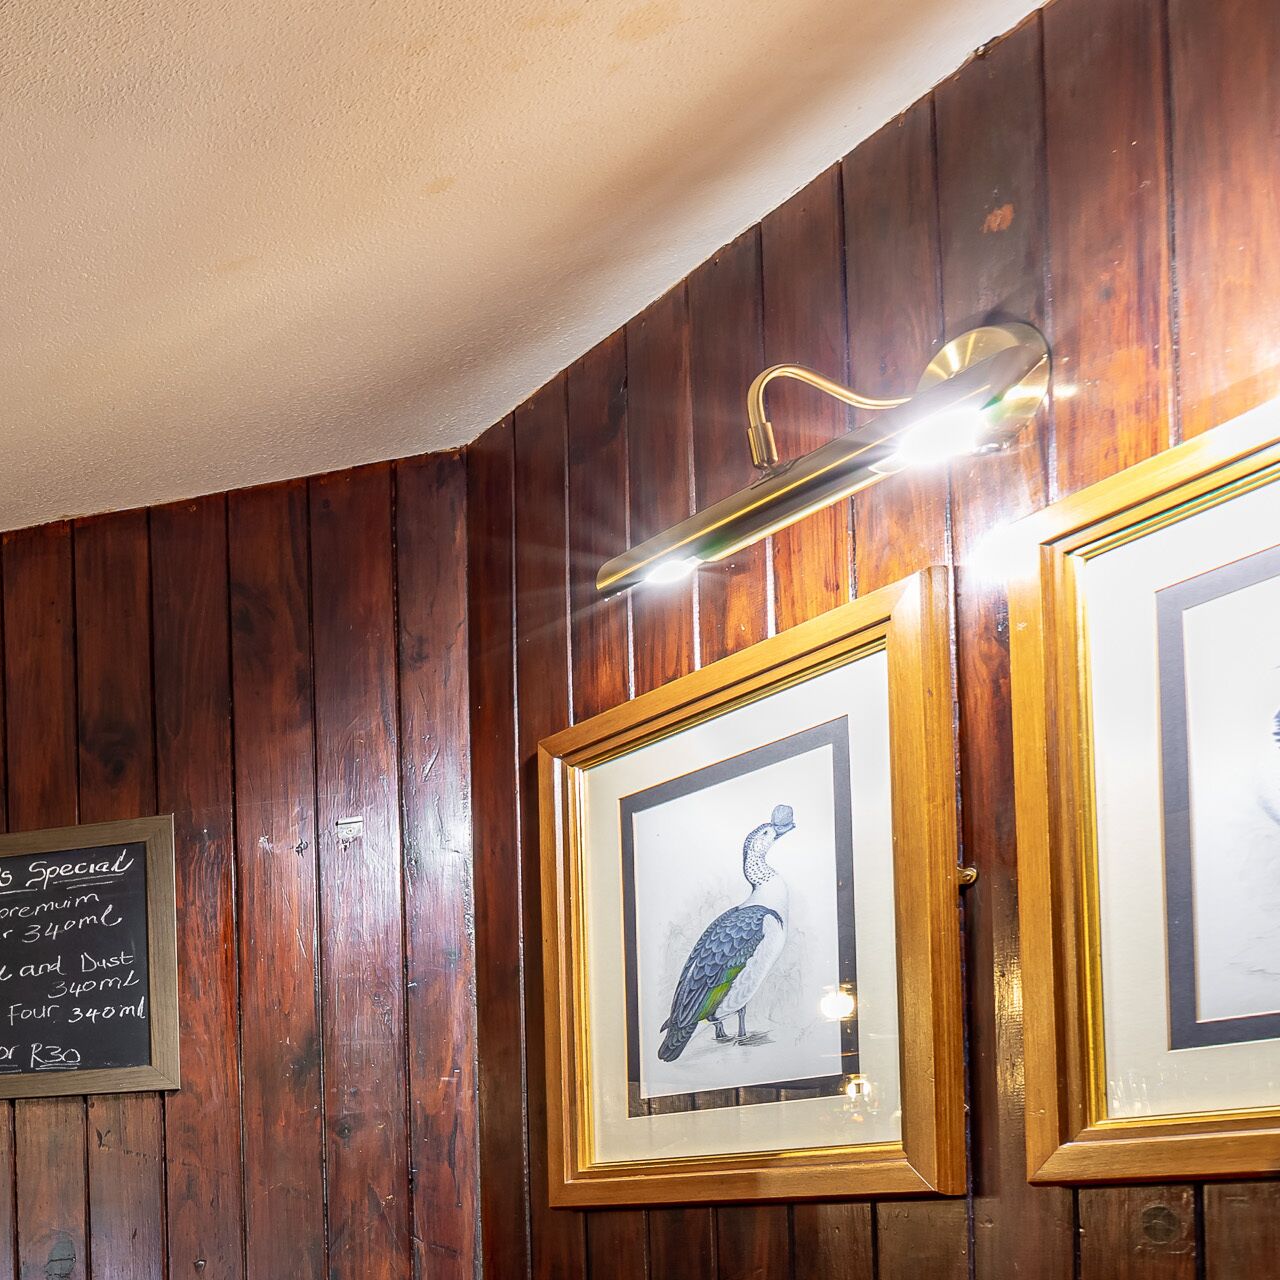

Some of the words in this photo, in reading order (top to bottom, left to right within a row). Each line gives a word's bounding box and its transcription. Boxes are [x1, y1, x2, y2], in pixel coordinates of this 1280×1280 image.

[26, 849, 134, 889] Special
[22, 904, 122, 943] 340ml
[19, 955, 67, 976] and
[81, 951, 134, 973] Dust
[48, 970, 140, 999] 340ml
[8, 1003, 60, 1026] Four
[68, 996, 146, 1023] 340ml
[30, 1042, 81, 1068] R30
